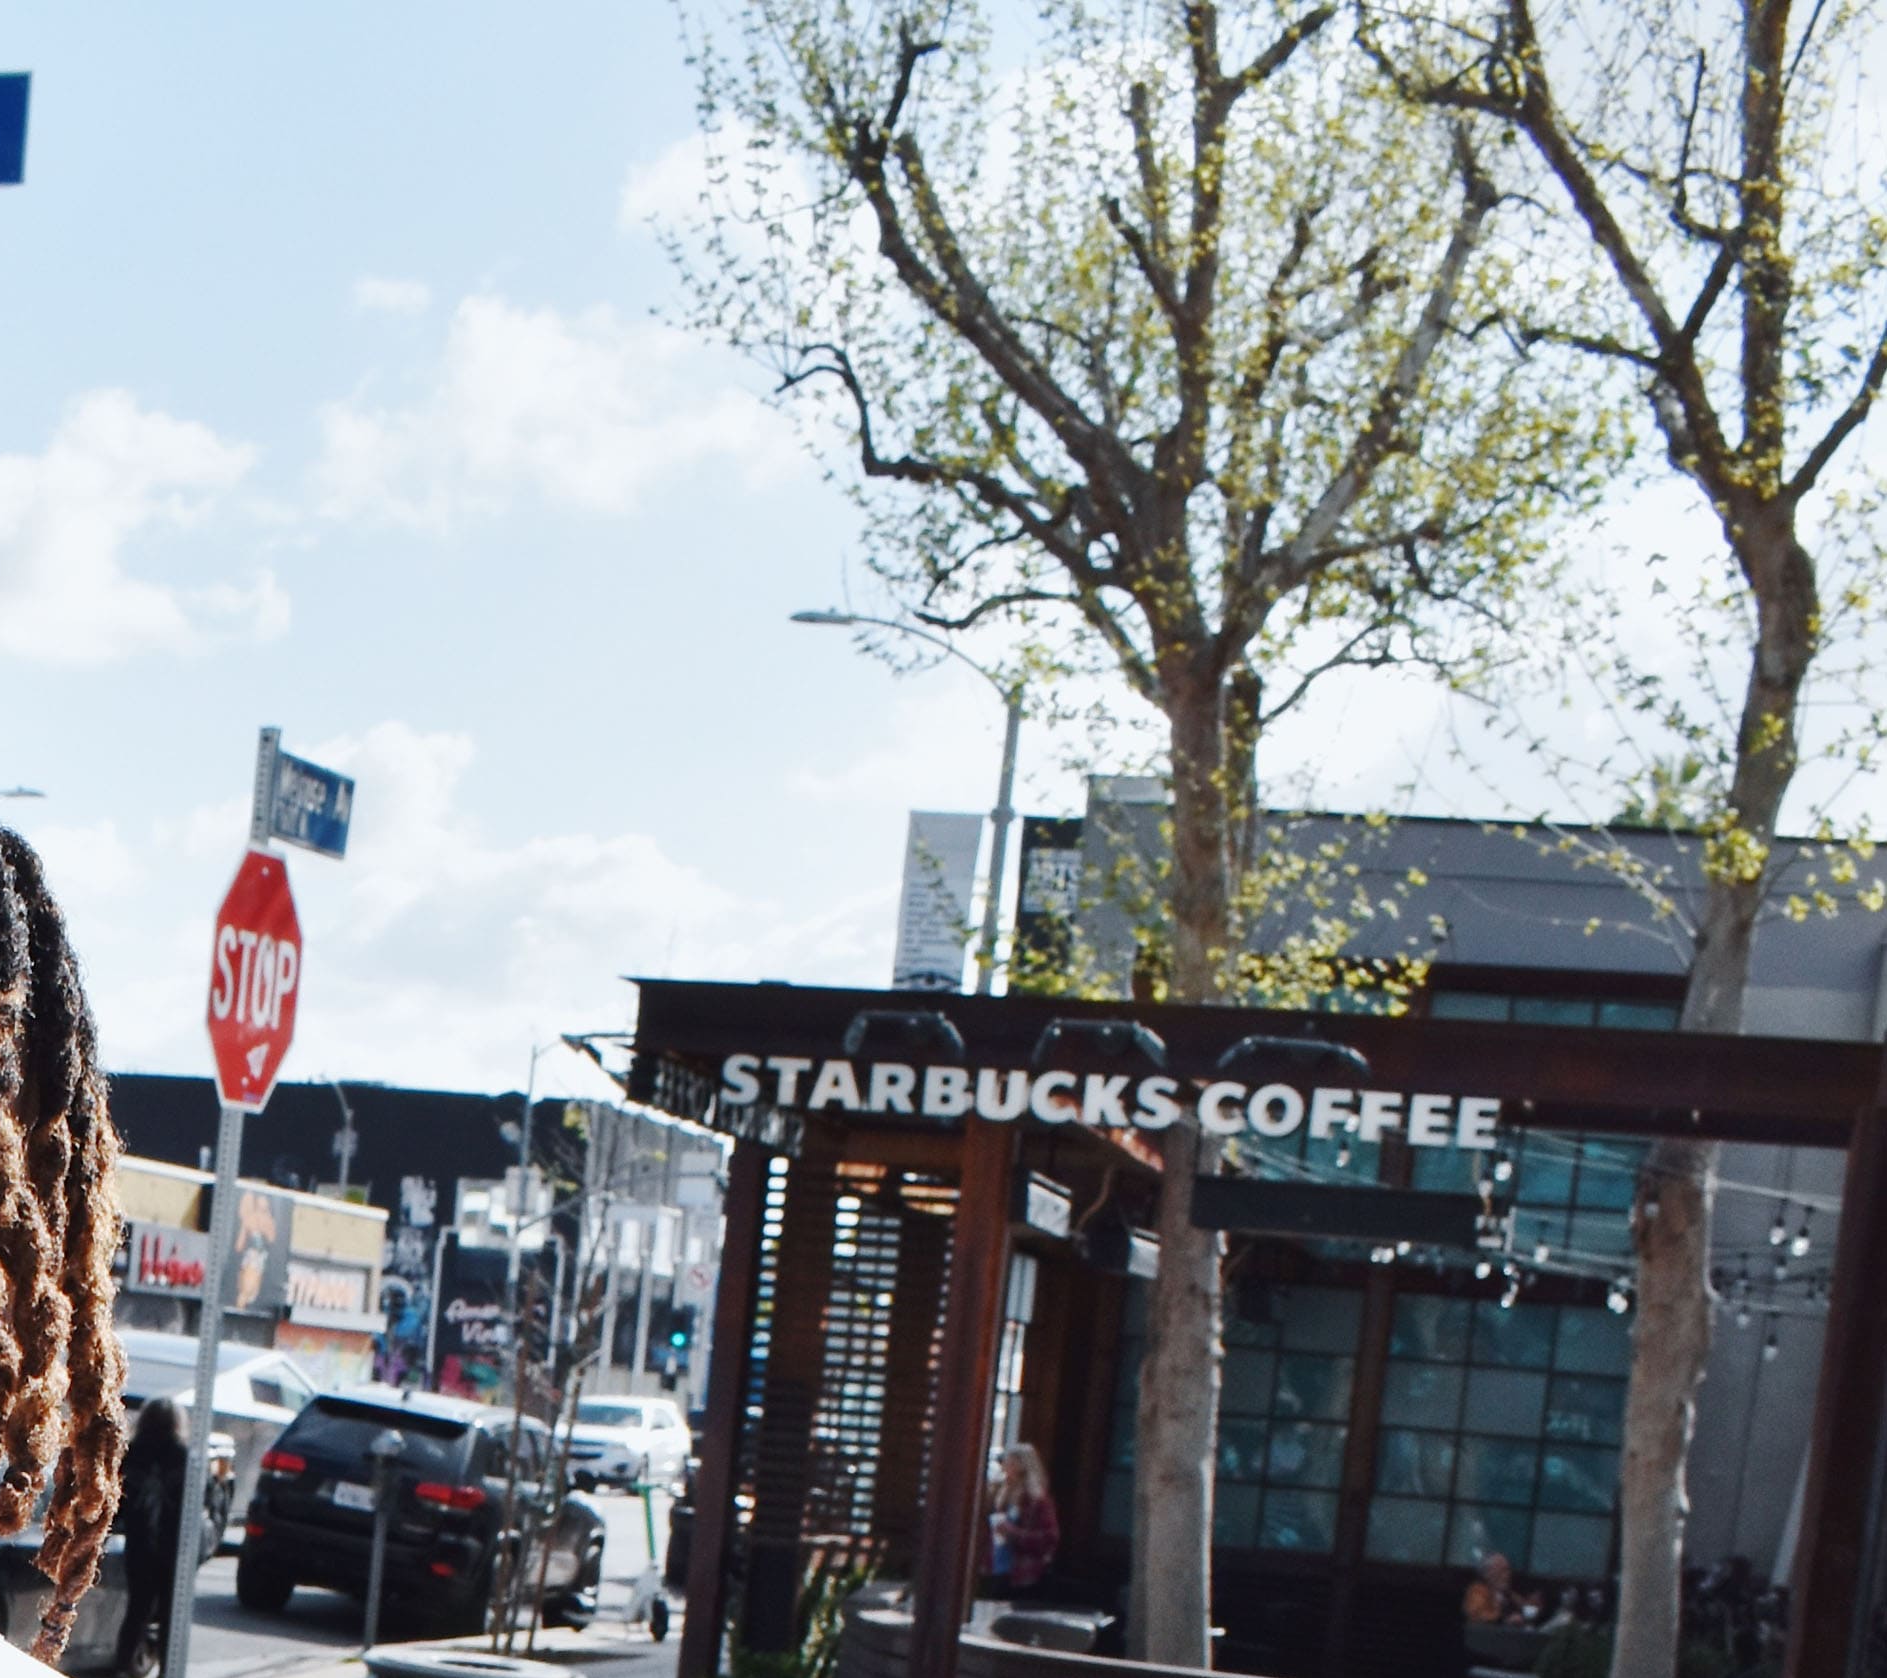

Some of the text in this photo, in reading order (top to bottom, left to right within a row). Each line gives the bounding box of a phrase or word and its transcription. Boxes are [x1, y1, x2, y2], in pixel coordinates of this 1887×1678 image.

[213, 923, 298, 1031] STOP
[719, 1052, 1502, 1150] STARBUCKS COFFEE
